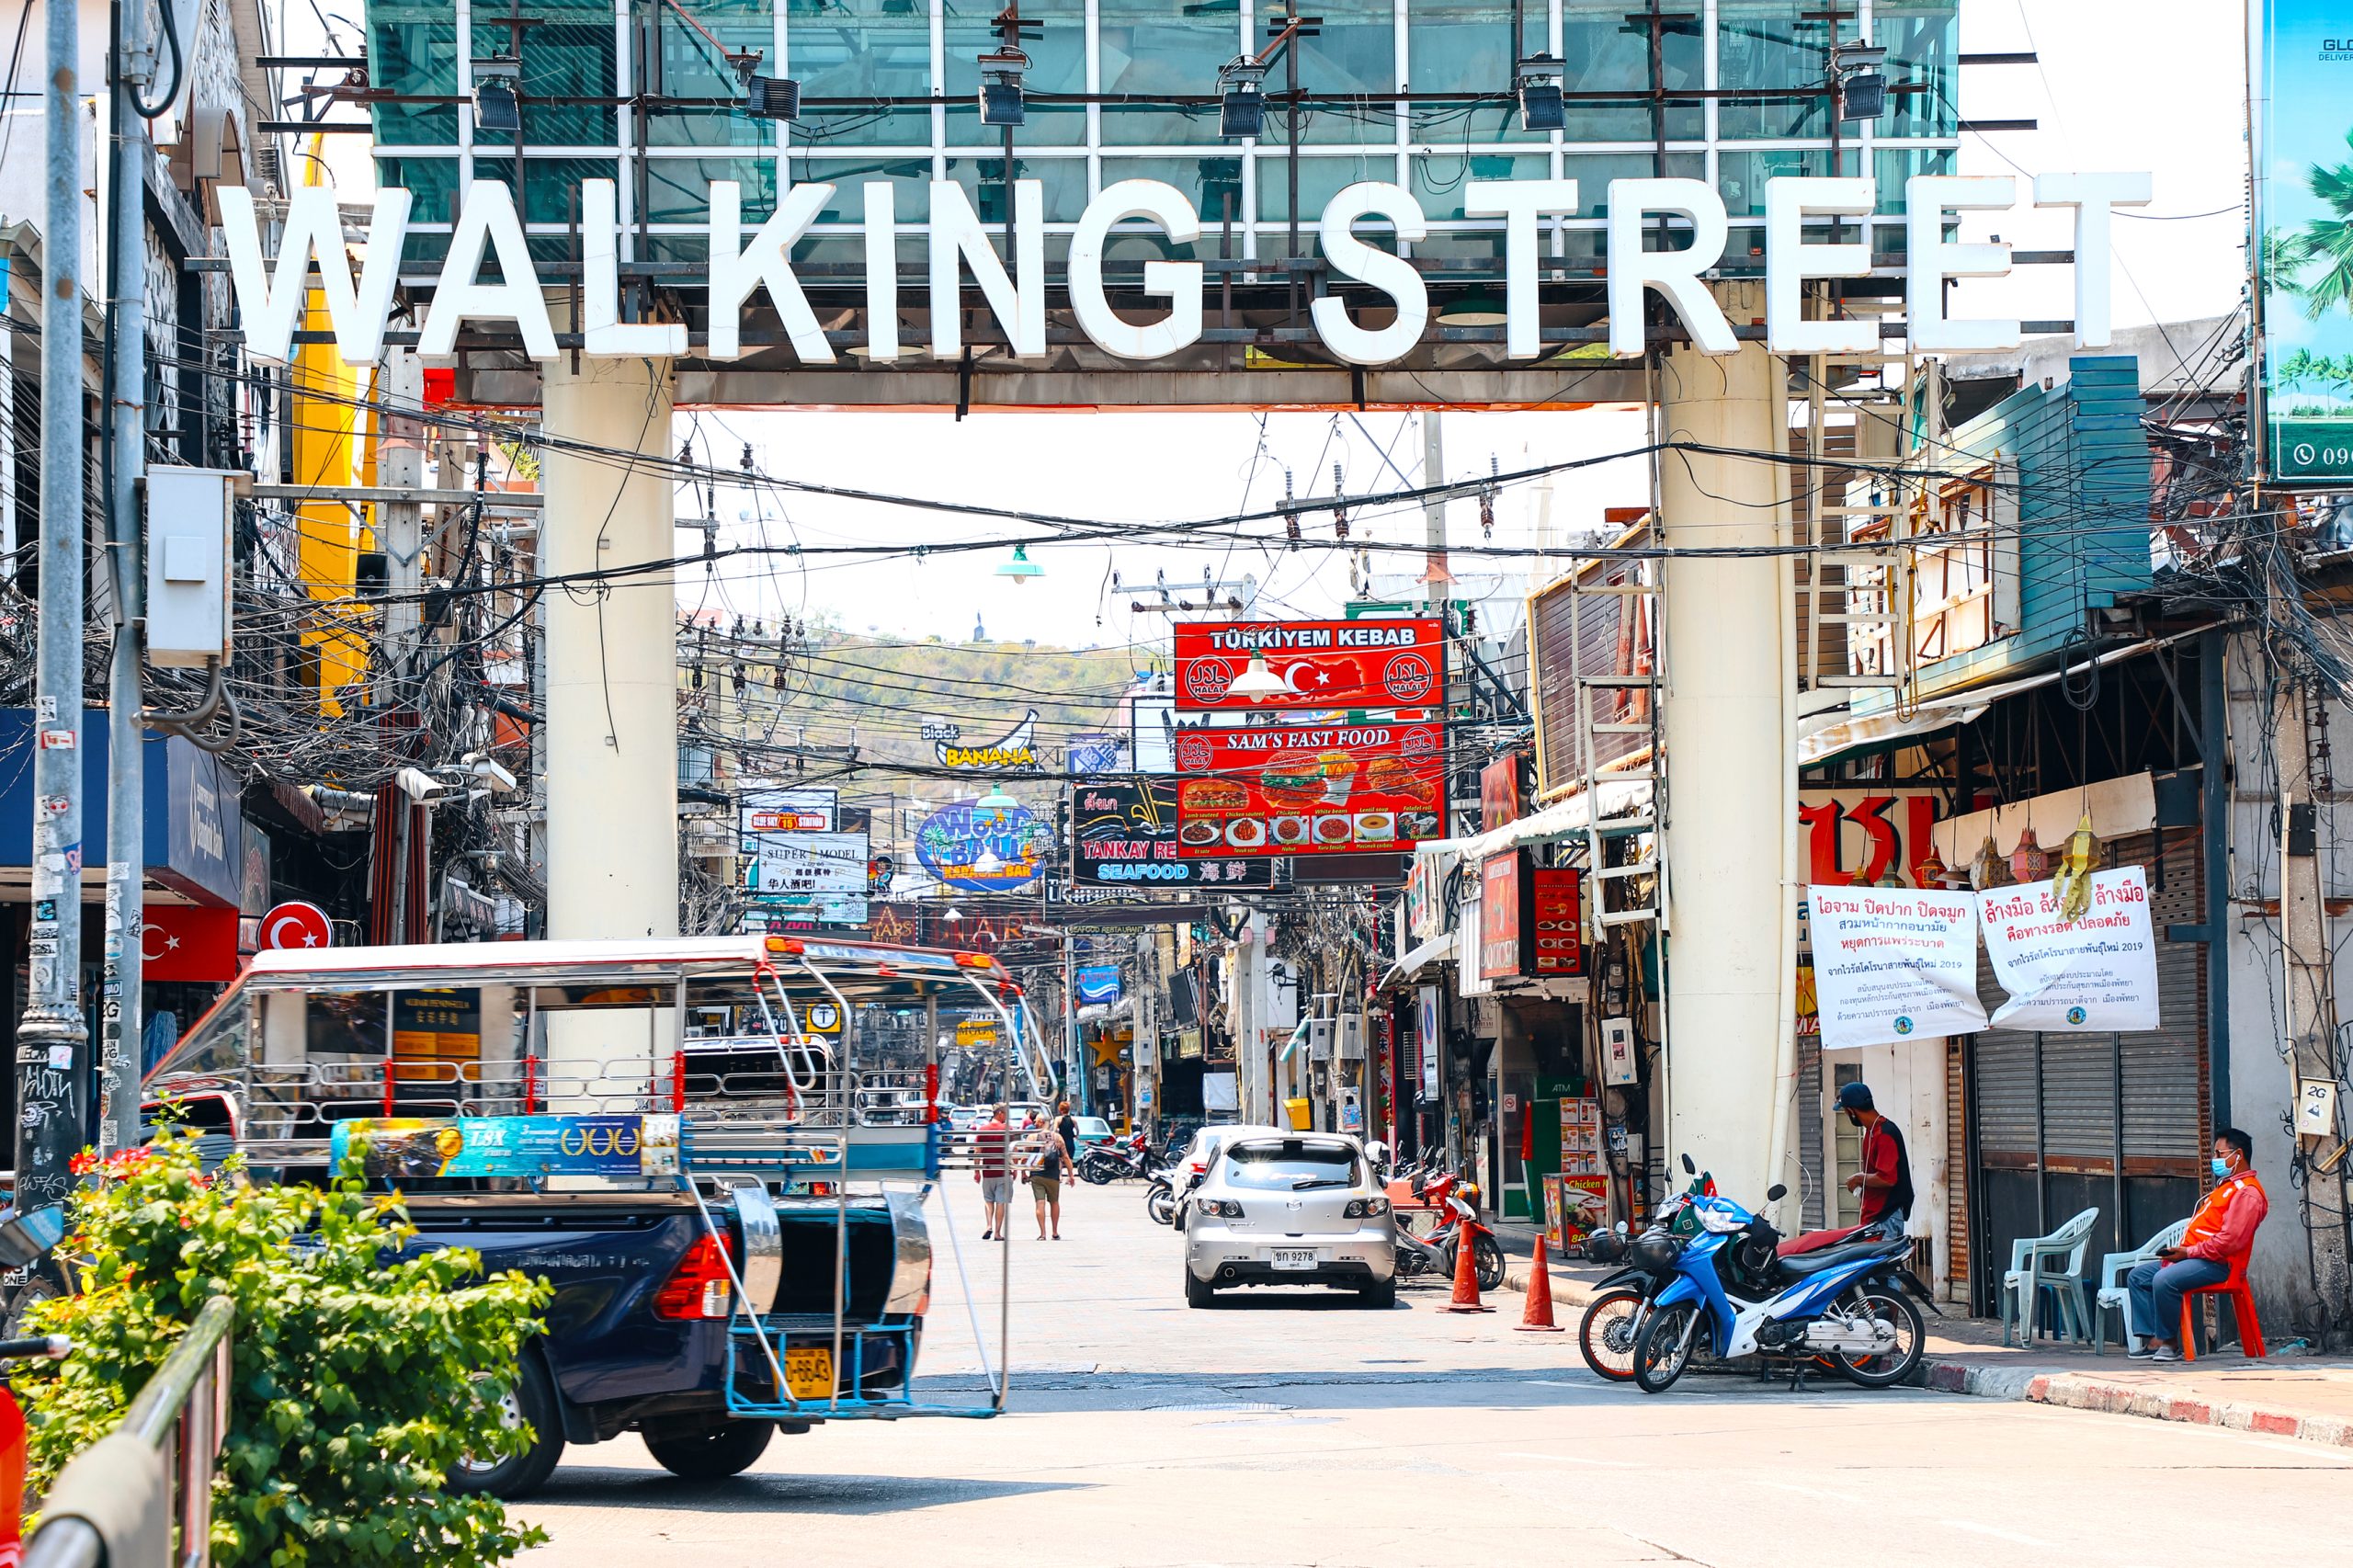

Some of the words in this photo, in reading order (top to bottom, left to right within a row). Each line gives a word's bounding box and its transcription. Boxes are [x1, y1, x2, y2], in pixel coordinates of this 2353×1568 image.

[217, 177, 1203, 367] WALKING
[1310, 172, 2153, 366] STREET
[2323, 448, 2353, 465] 09
[1338, 629, 1415, 646] KEBAB
[1195, 686, 1225, 694] HALAL
[922, 724, 960, 740] Black
[1287, 731, 1333, 748] FAST
[1336, 729, 1391, 745] FOOD
[946, 746, 1035, 767] BANANA
[753, 815, 767, 827] BLUE
[767, 815, 779, 827] SKY
[782, 819, 792, 828] 15
[798, 815, 824, 827] STATION
[767, 849, 806, 858] SUPER
[820, 849, 858, 859] MODEL
[1082, 840, 1150, 859] TANKAY
[1154, 840, 1176, 859] RE
[1006, 866, 1031, 878] BAR
[1097, 864, 1188, 881] SEAFOOD
[1817, 894, 1859, 915] ไอจาม
[1865, 898, 1912, 916] ปิดปาก
[1917, 901, 1965, 924] ปิดจมูก
[1985, 897, 2034, 924] ล้างมือ
[2095, 880, 2143, 905] ล้างมือ
[2006, 921, 2073, 942] คือทางรอด
[2077, 911, 2131, 930] ปลอดภัย
[2122, 942, 2143, 951] 2019
[1940, 960, 1962, 969] 2019
[2307, 1085, 2326, 1098] 2G
[1569, 1178, 1600, 1188] Chicken
[1292, 1252, 1313, 1261] 9278
